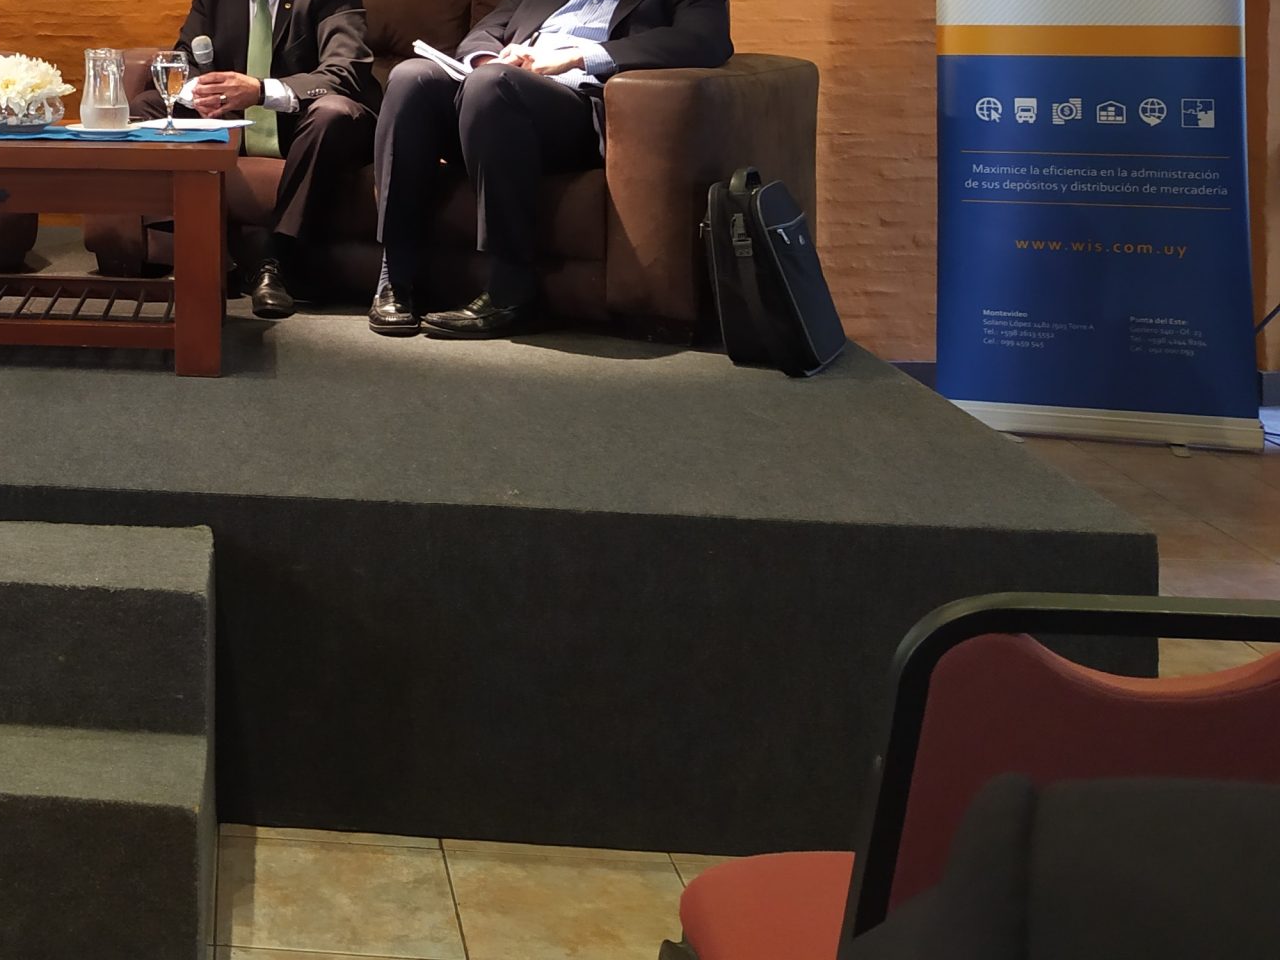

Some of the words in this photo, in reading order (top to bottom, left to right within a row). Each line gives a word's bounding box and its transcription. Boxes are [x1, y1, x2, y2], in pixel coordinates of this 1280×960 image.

[972, 164, 1027, 175] Maximice
[1030, 165, 1040, 175] la
[1042, 165, 1098, 176] eficiencia
[1100, 168, 1115, 177] en
[1117, 168, 1128, 177] la
[1130, 168, 1220, 180] administración
[964, 178, 979, 189] de
[981, 180, 1000, 189] sus
[1002, 179, 1058, 192] depósitos
[1061, 183, 1068, 193] y
[1070, 180, 1140, 193] distribución
[1142, 183, 1158, 193] de
[1016, 239, 1187, 258] www.wis.com.uy
[982, 309, 1028, 318] Montevideo
